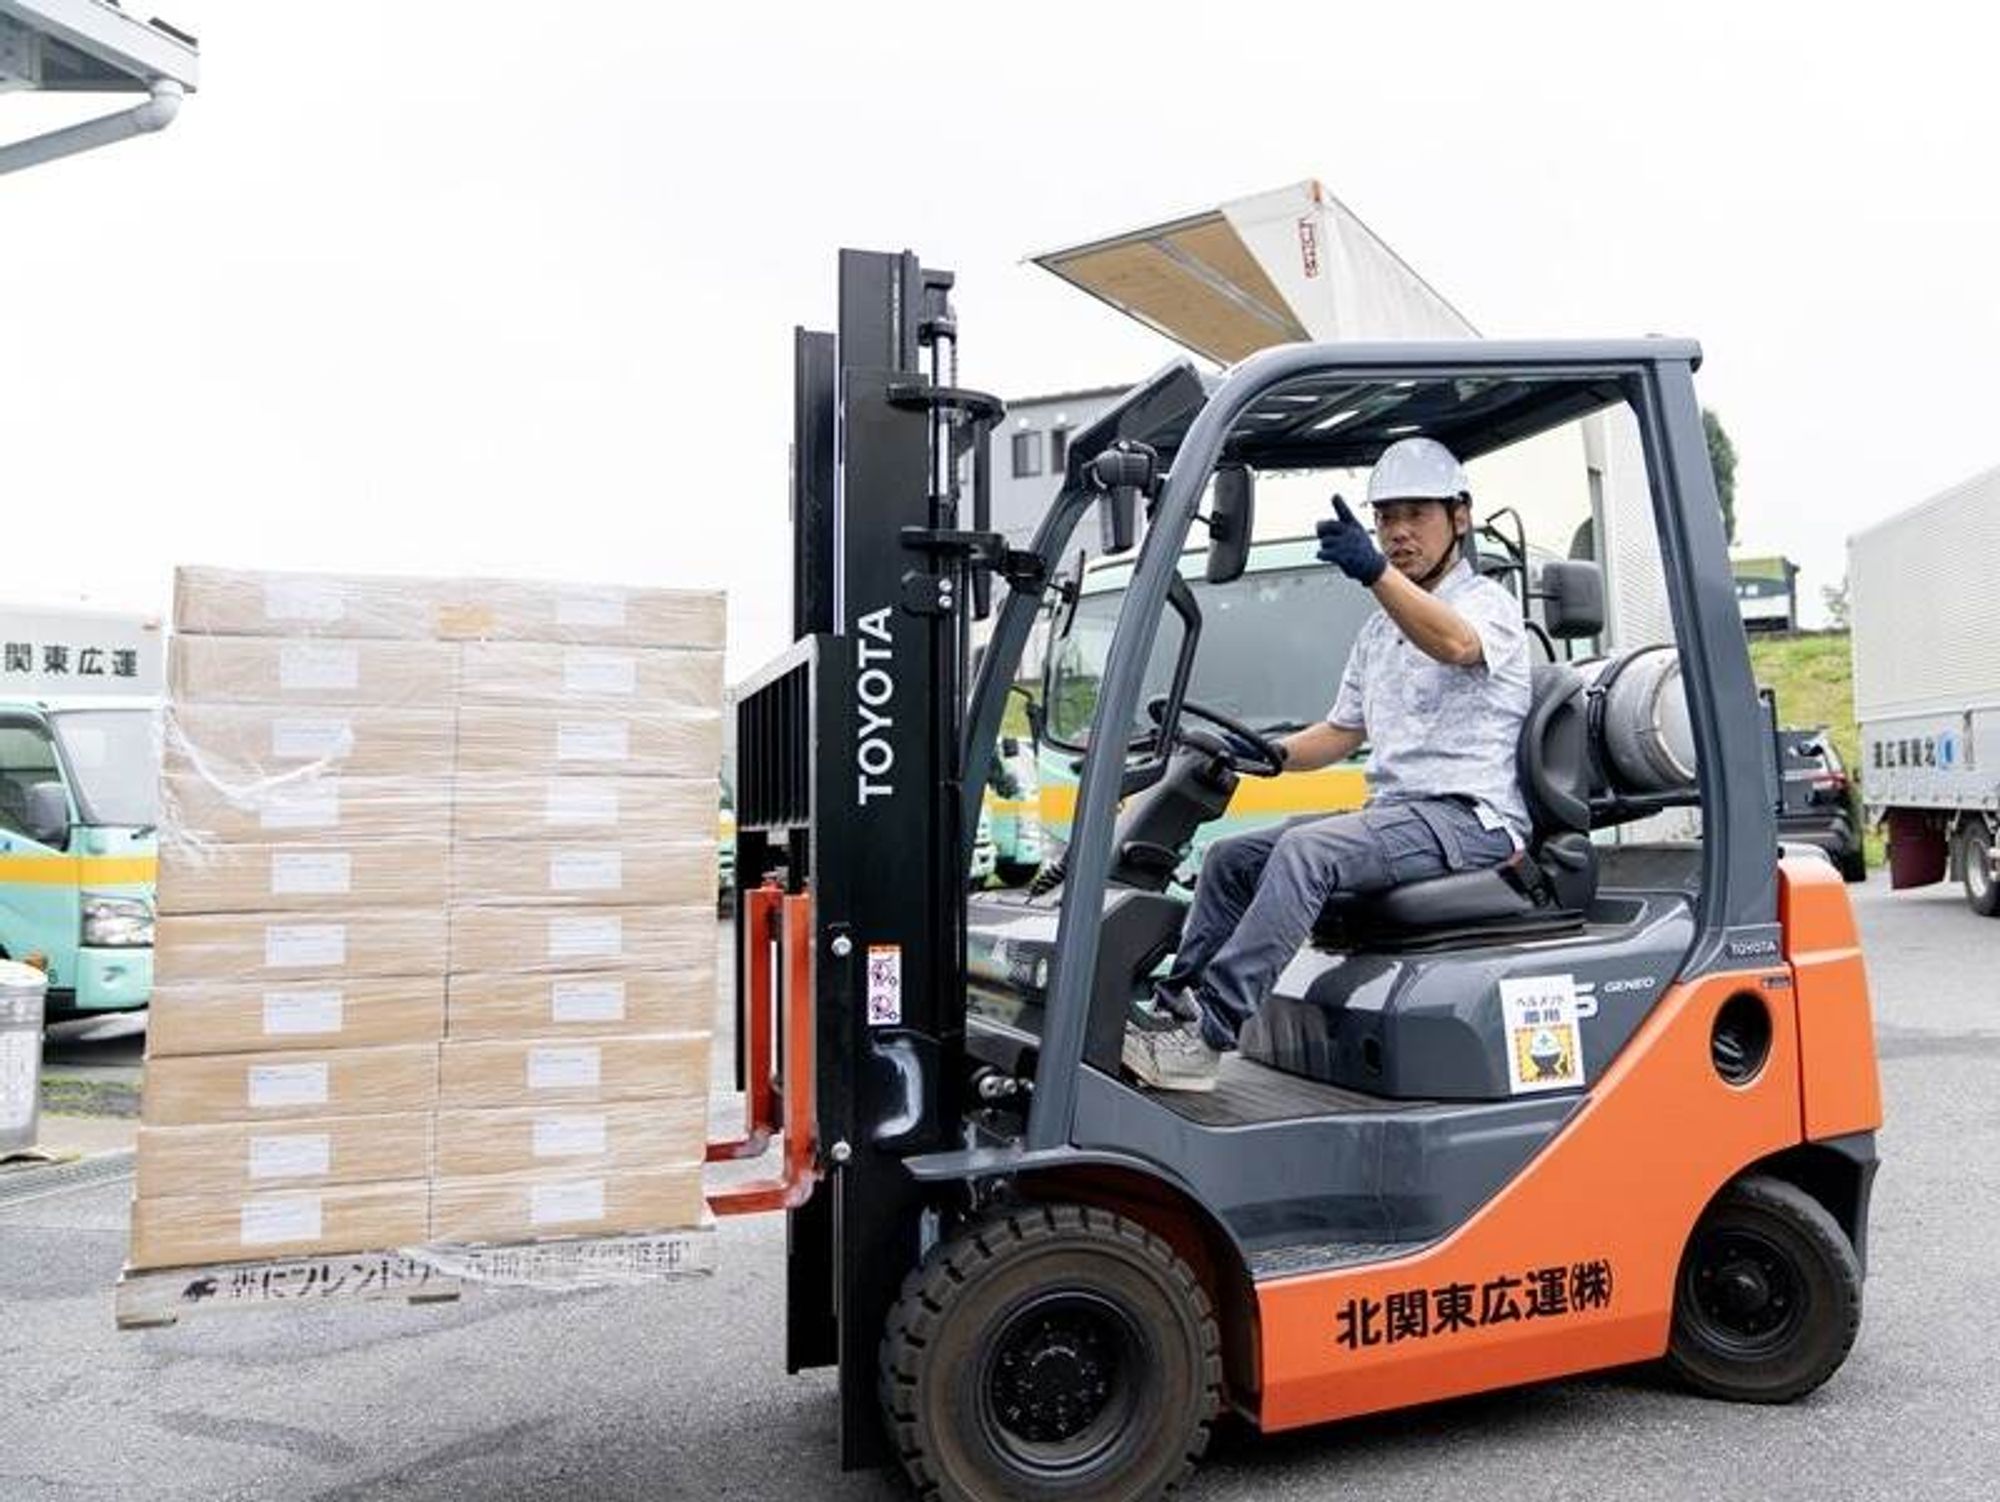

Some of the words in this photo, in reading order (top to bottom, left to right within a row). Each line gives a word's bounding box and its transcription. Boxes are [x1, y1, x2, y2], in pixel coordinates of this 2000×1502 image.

[4, 642, 138, 677] 関東広運
[857, 606, 894, 805] TOYOTA
[1731, 941, 1776, 955] TOYOTA
[1604, 977, 1656, 993] GENEO
